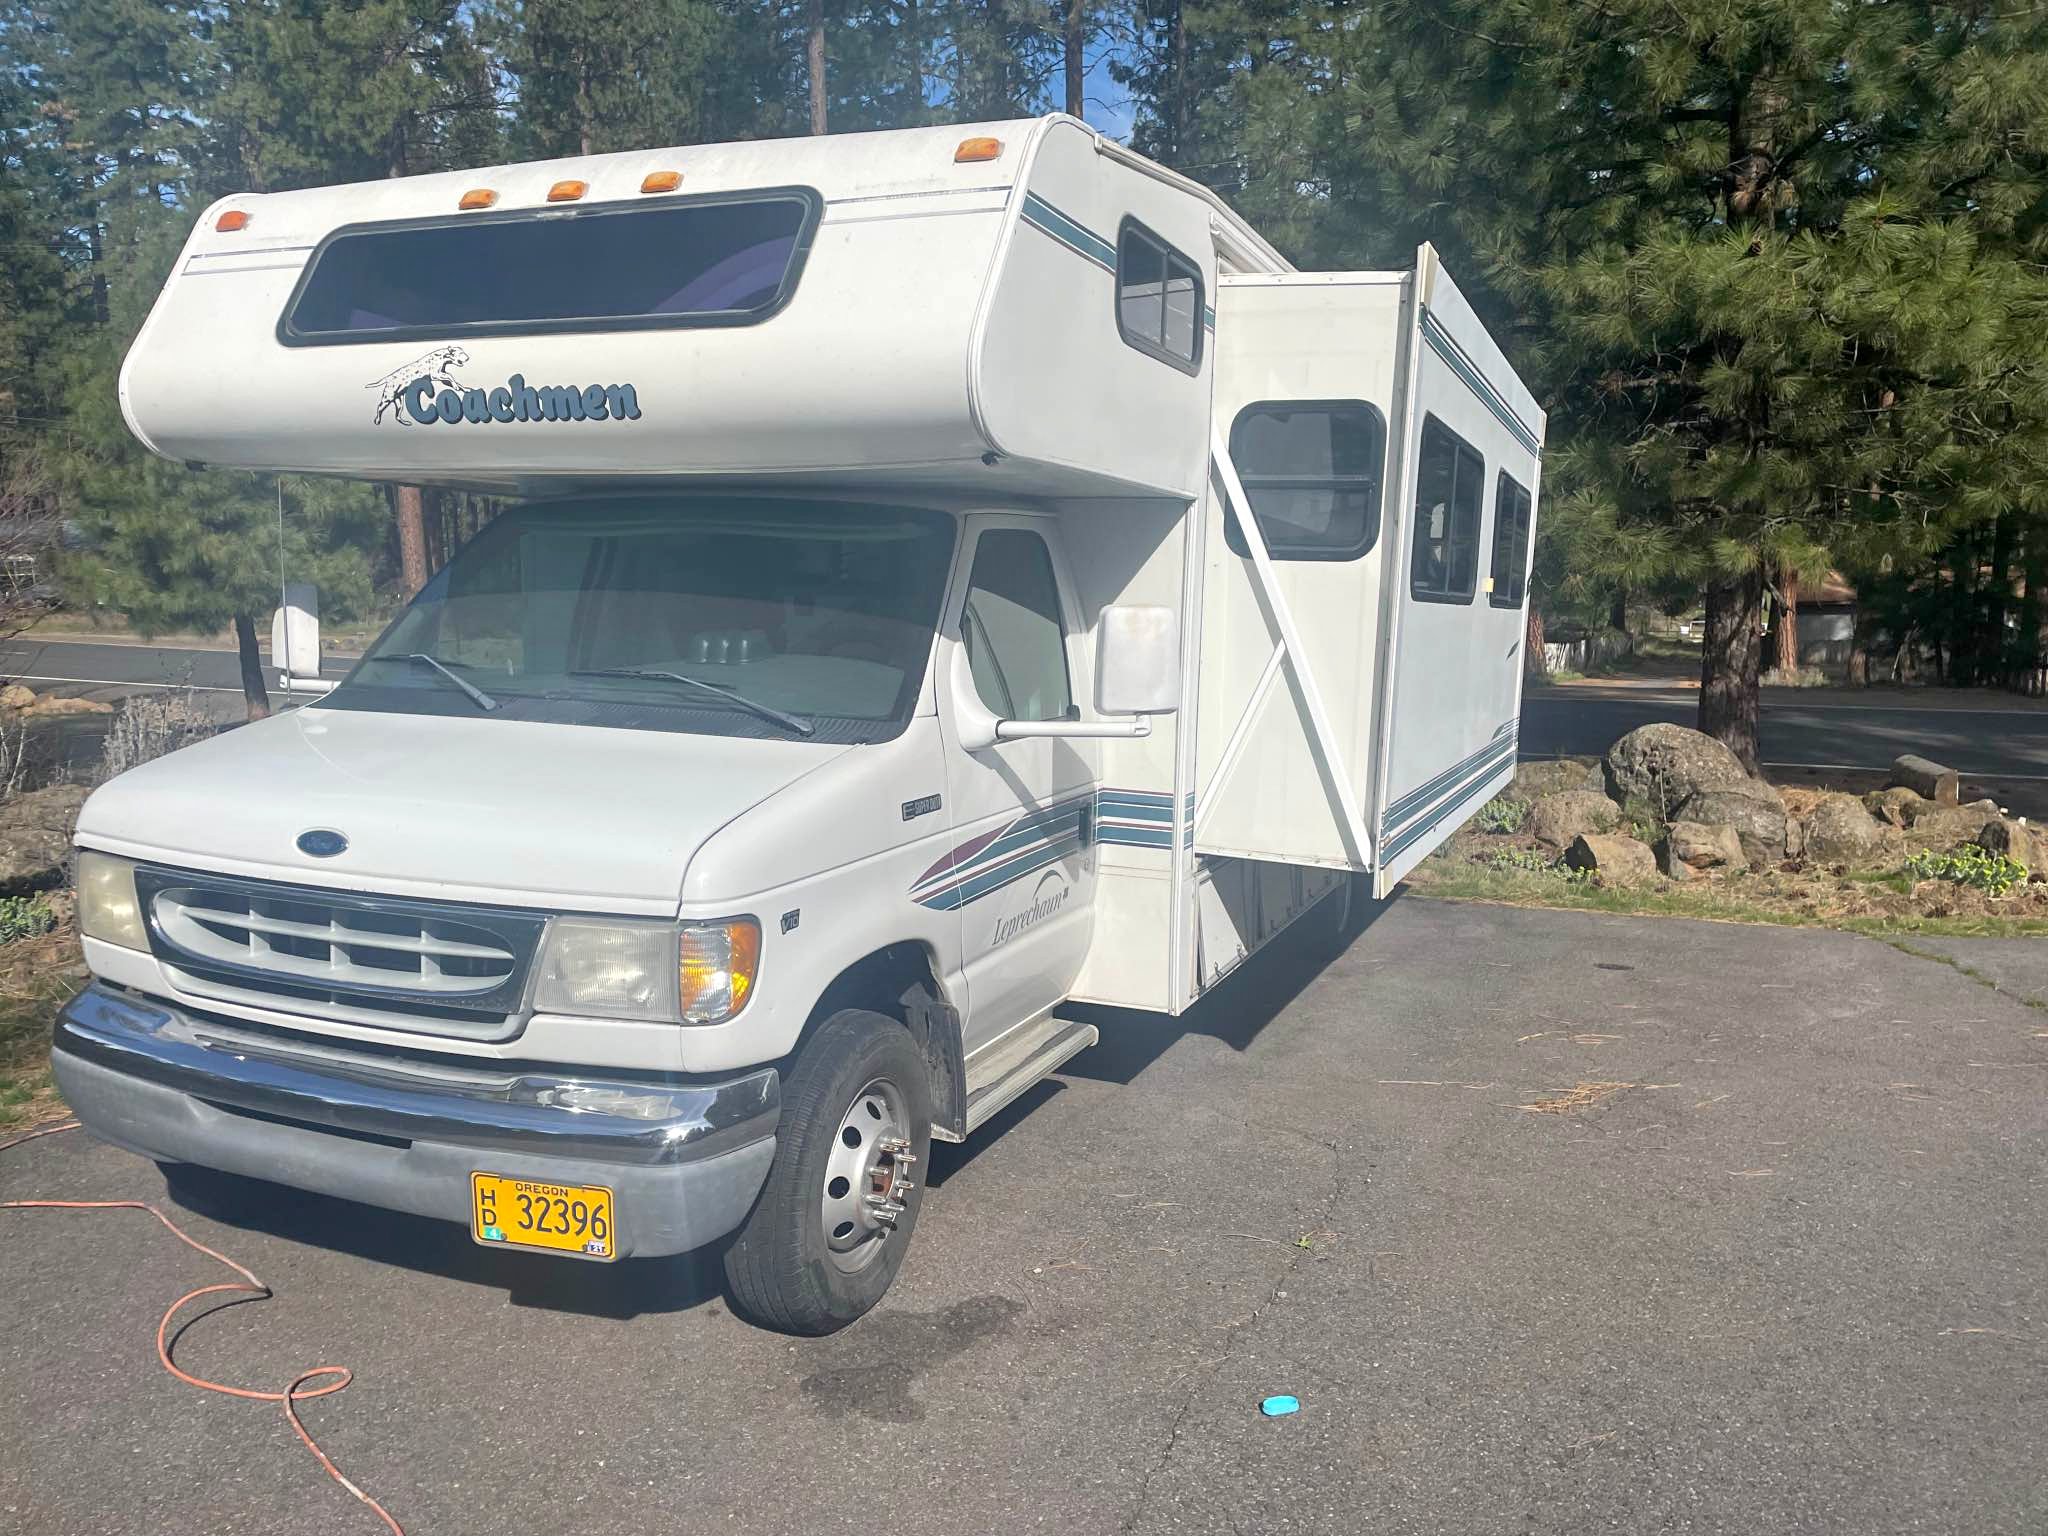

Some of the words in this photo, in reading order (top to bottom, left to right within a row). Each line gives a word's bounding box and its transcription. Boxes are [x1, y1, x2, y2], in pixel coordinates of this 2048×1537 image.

[405, 374, 642, 425] Coachmen
[781, 916, 799, 934] V10
[991, 891, 1062, 946] Leprechaun
[515, 1182, 569, 1198] OREGON
[516, 1194, 607, 1240] 32396
